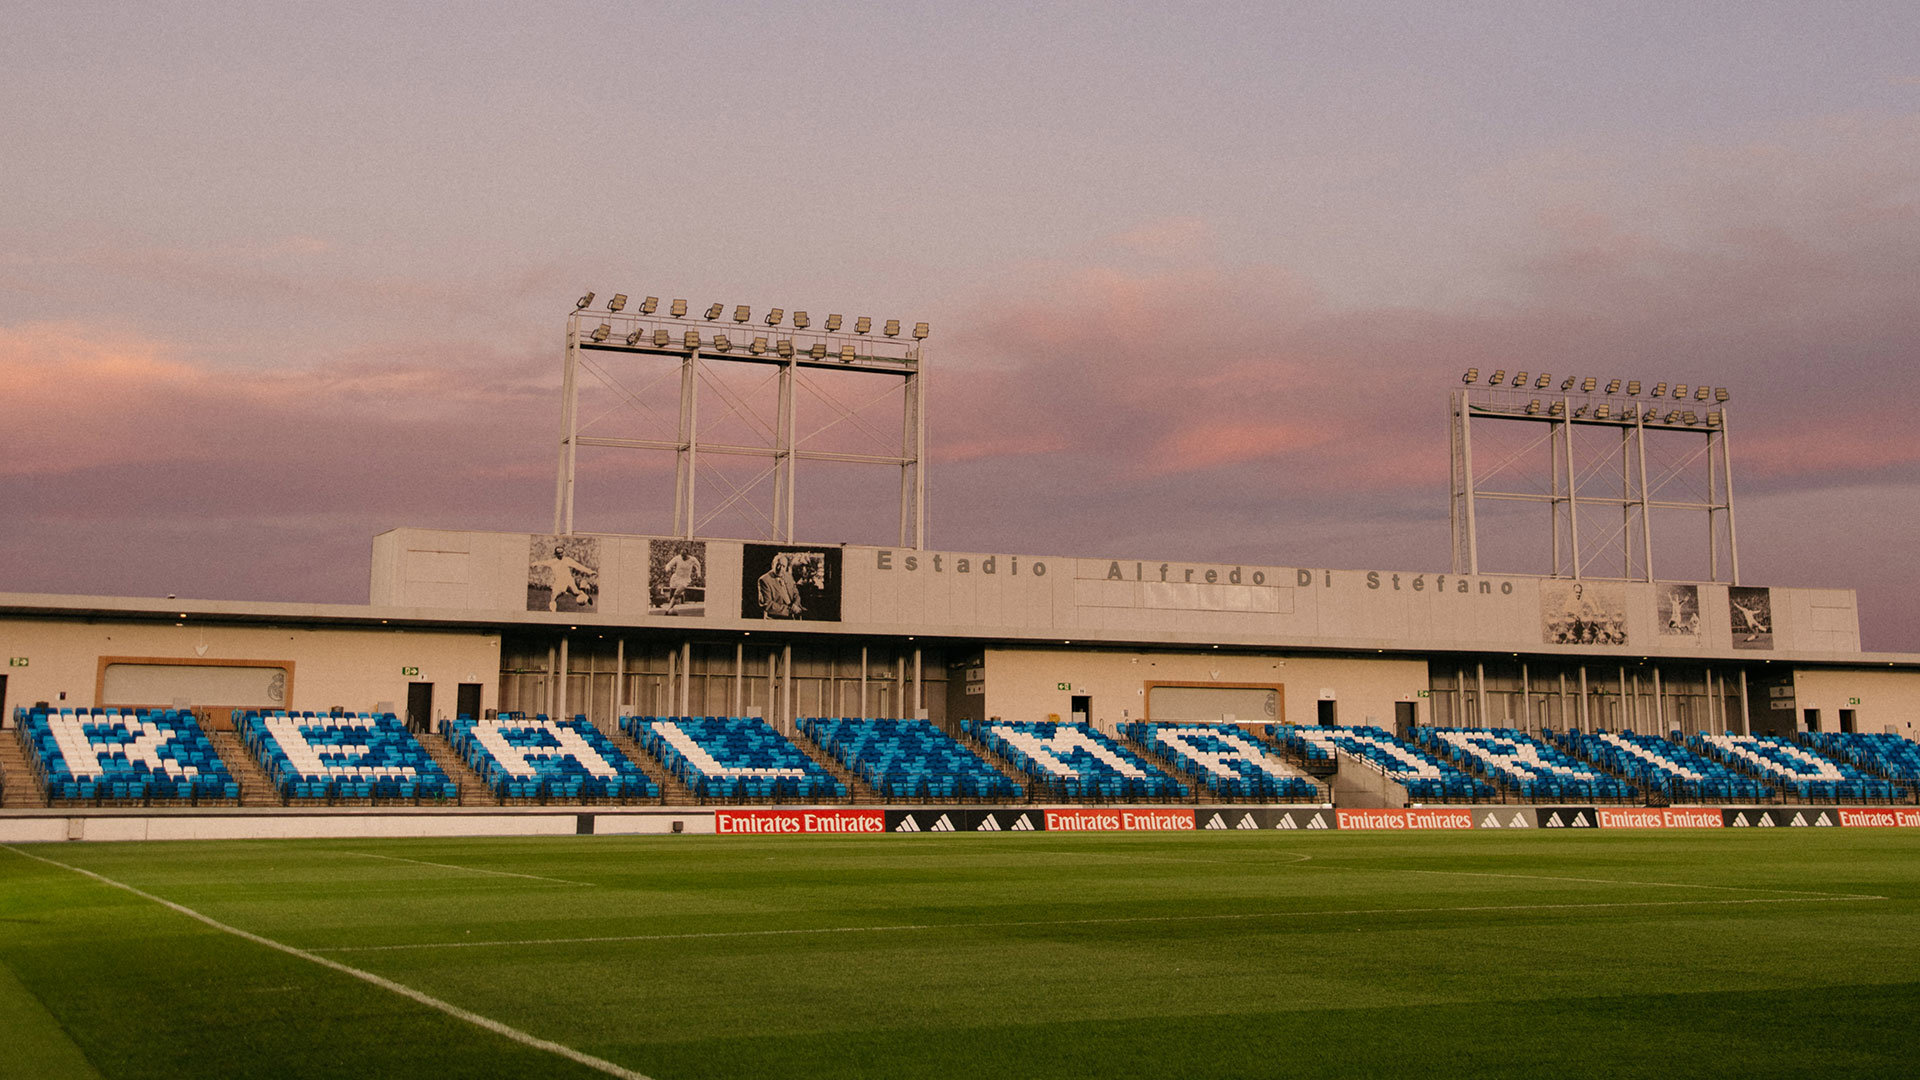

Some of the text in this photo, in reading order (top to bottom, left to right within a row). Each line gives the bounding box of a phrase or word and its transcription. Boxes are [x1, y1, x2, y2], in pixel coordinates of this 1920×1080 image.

[877, 551, 1513, 595] Estadio Alfredo Di Stéfano
[47, 714, 805, 781] REAL
[718, 813, 883, 833] Emirates Emirates
[1047, 812, 1194, 830] Emirates Emirates
[1338, 812, 1472, 830] Emirates Emirates
[1601, 811, 1722, 828] Emirates Emirates
[1840, 811, 1895, 827] Emirates
